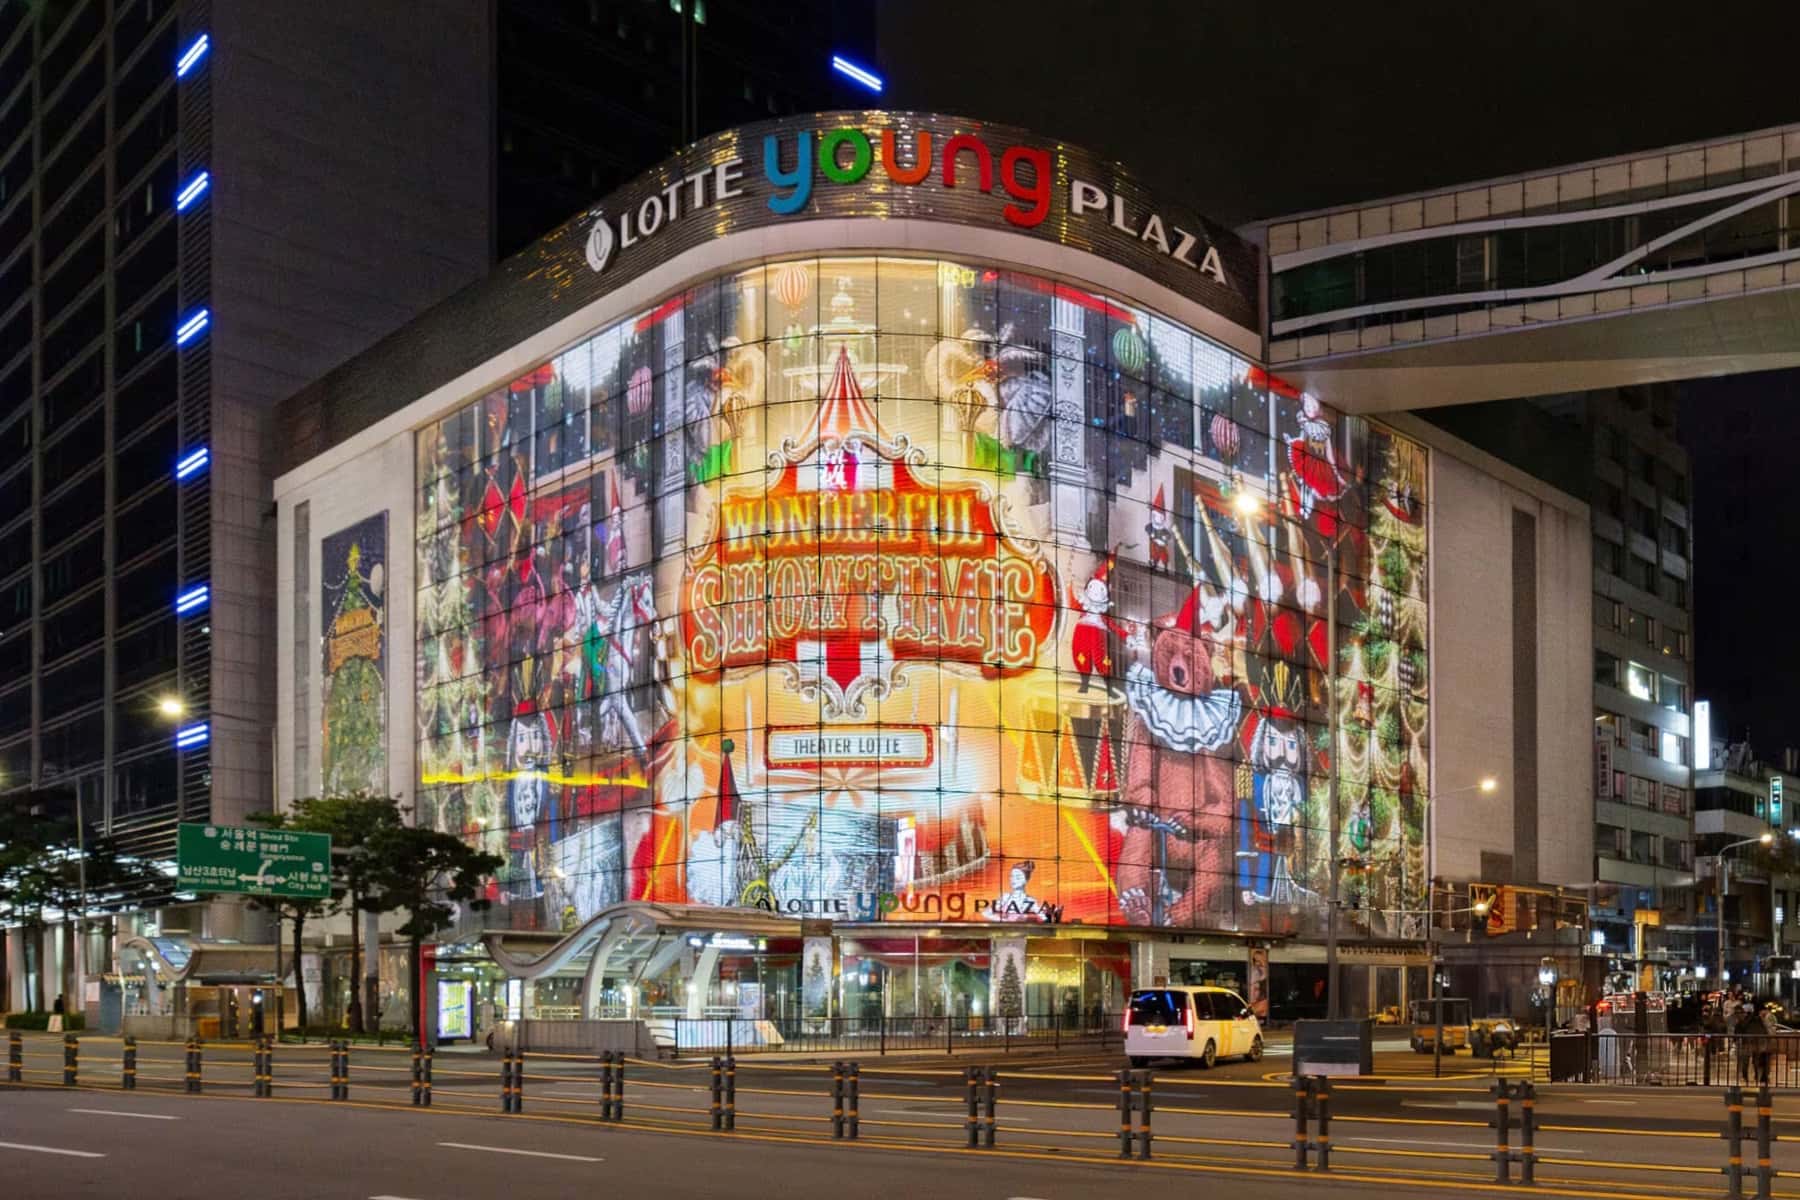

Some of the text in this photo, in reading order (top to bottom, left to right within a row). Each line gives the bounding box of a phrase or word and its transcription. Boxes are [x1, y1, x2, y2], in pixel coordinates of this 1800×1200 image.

[621, 127, 1227, 285] LOTTE young PLAZA
[721, 493, 984, 554] WONDERFUL
[690, 554, 1036, 673] SHOWTIME
[794, 737, 901, 755] THEATER LOTTE
[776, 892, 1053, 921] LOTTE young PLAZA
